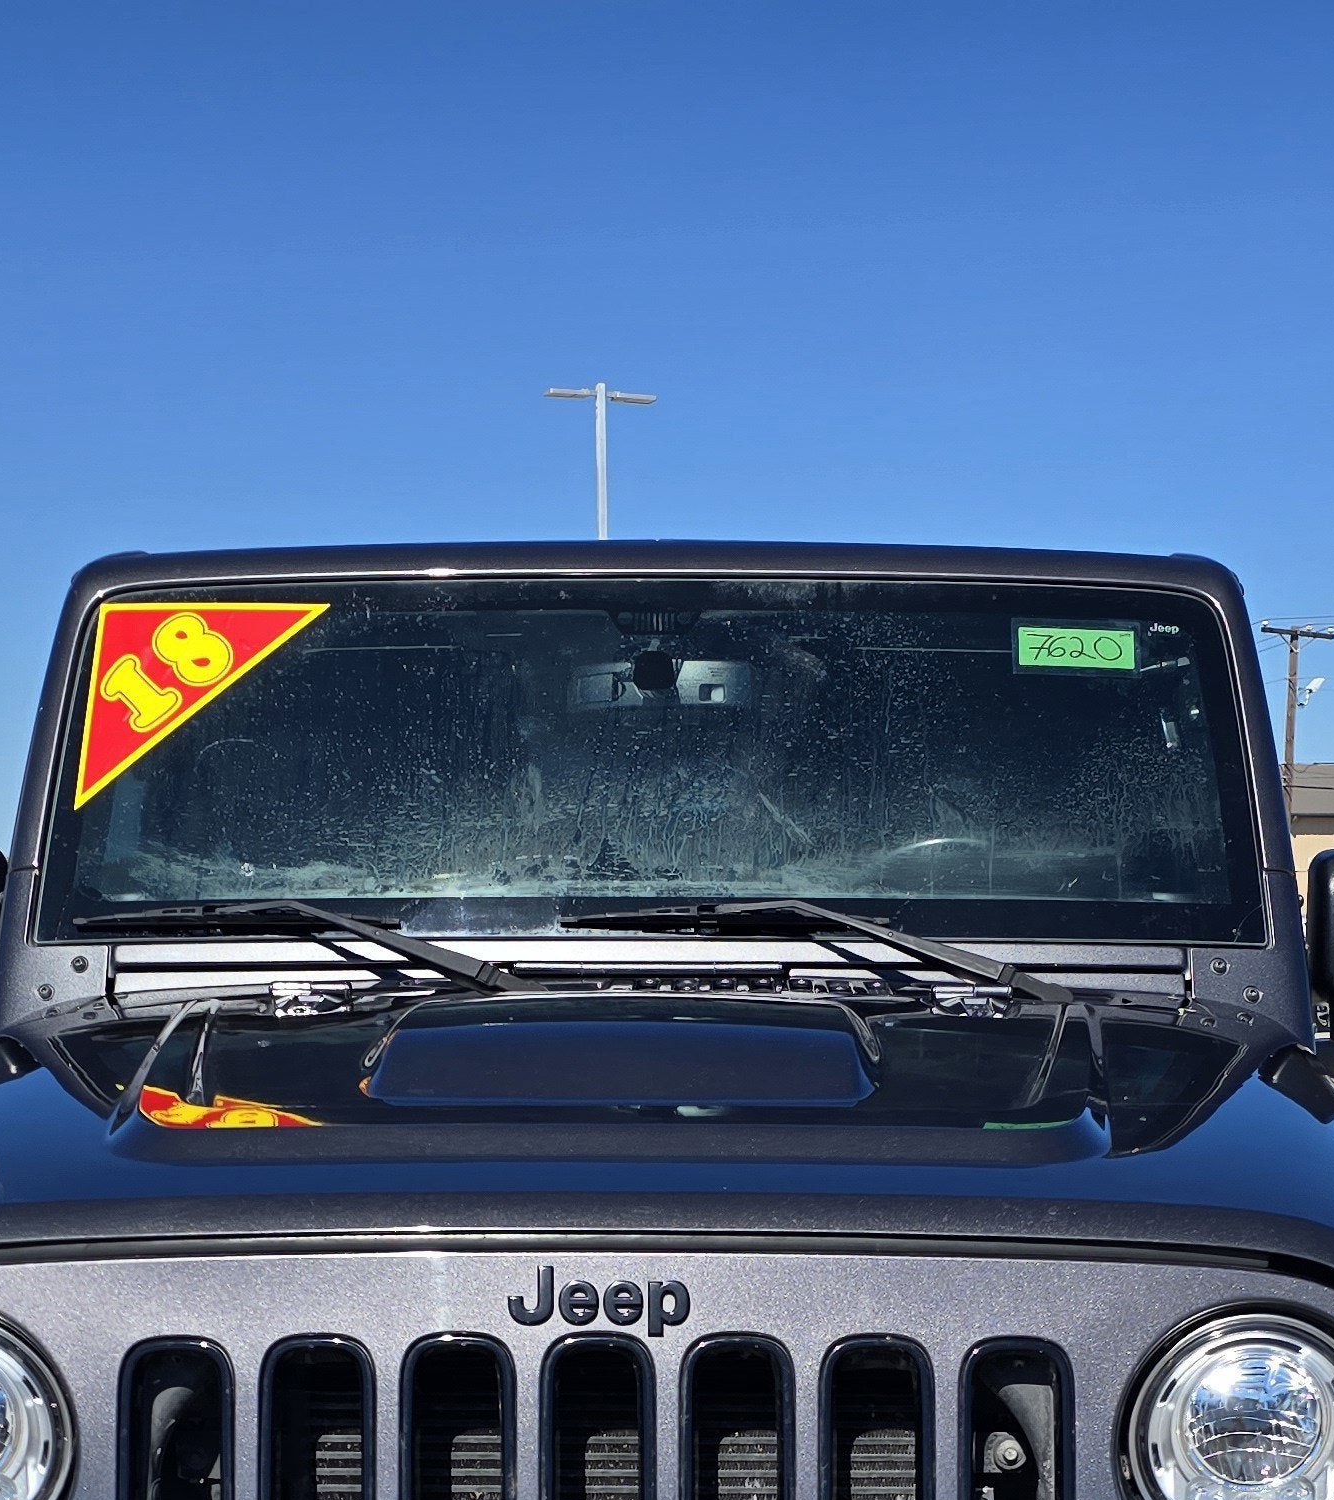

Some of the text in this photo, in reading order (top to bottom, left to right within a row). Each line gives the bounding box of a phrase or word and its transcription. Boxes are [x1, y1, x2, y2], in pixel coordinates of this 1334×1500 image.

[1026, 633, 1123, 661] 7620
[1149, 622, 1180, 635] Jeep
[100, 611, 233, 732] 18
[507, 1265, 691, 1338] Jeep
